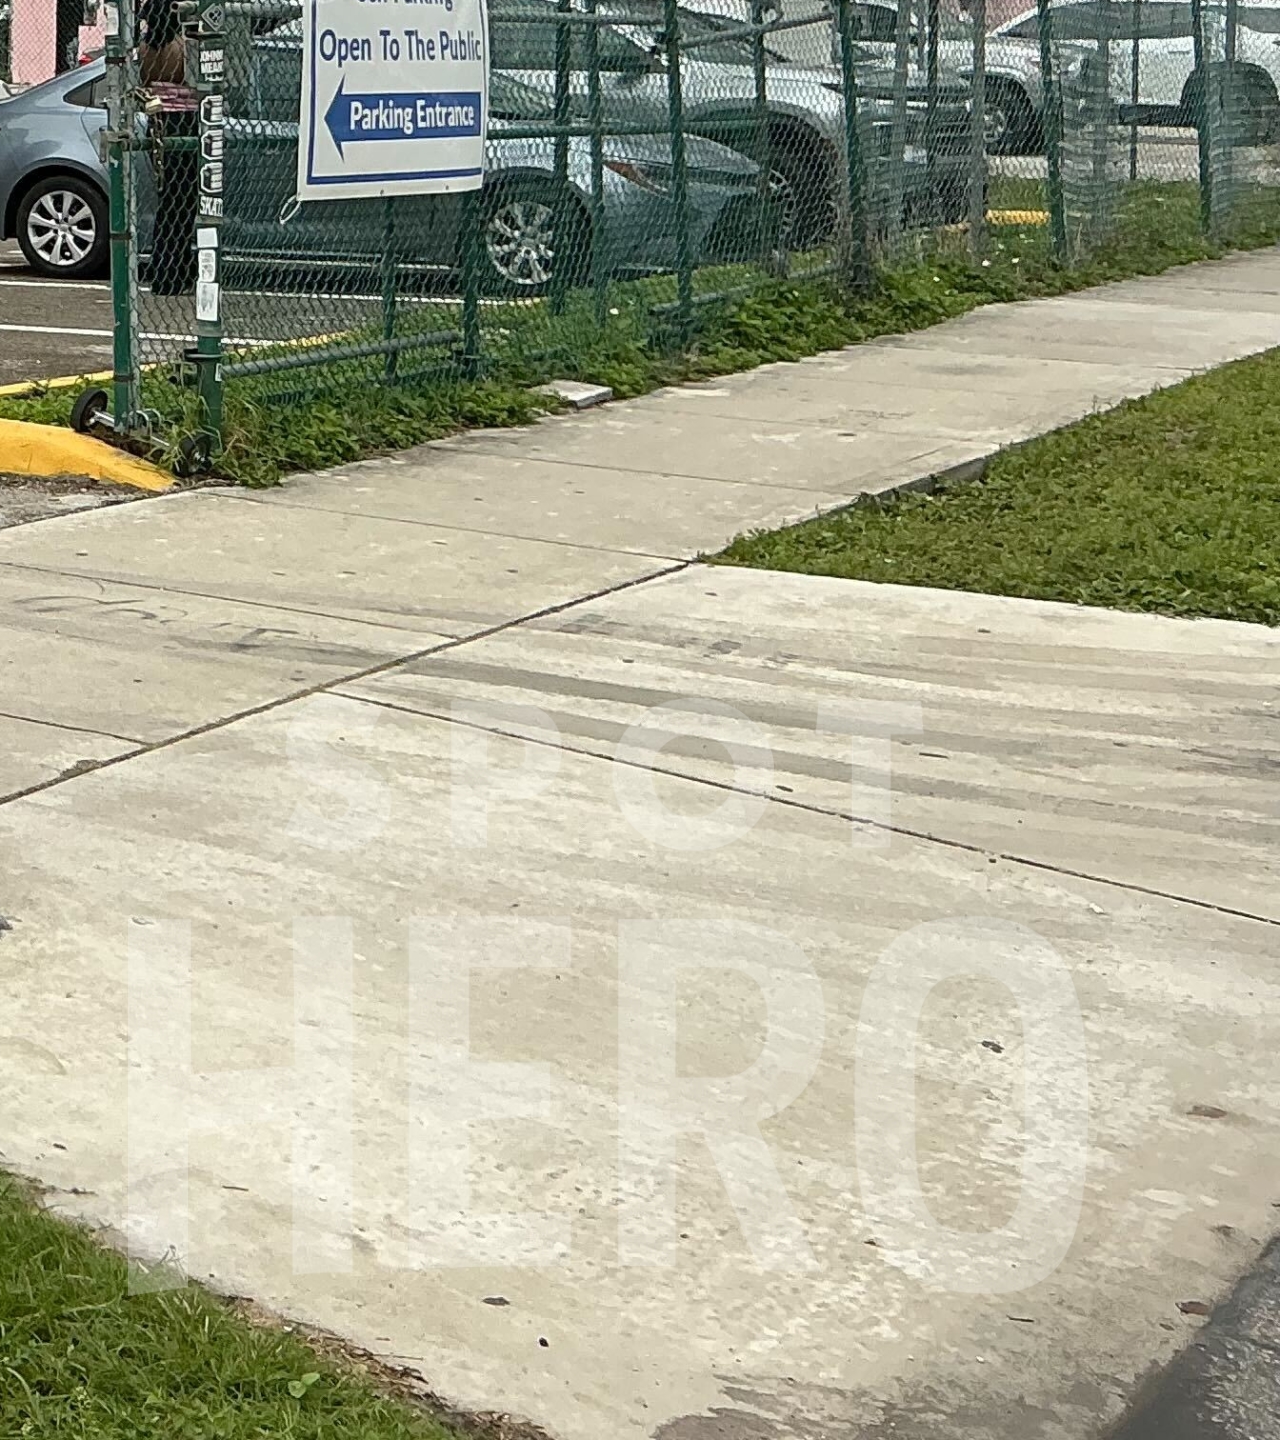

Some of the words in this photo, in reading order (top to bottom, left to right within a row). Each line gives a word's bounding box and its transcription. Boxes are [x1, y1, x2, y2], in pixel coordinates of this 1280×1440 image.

[319, 29, 371, 68] Open
[379, 30, 400, 61] To
[404, 30, 436, 61] The
[440, 30, 482, 62] Public
[350, 100, 414, 135] Parking
[416, 99, 475, 128] Entrance
